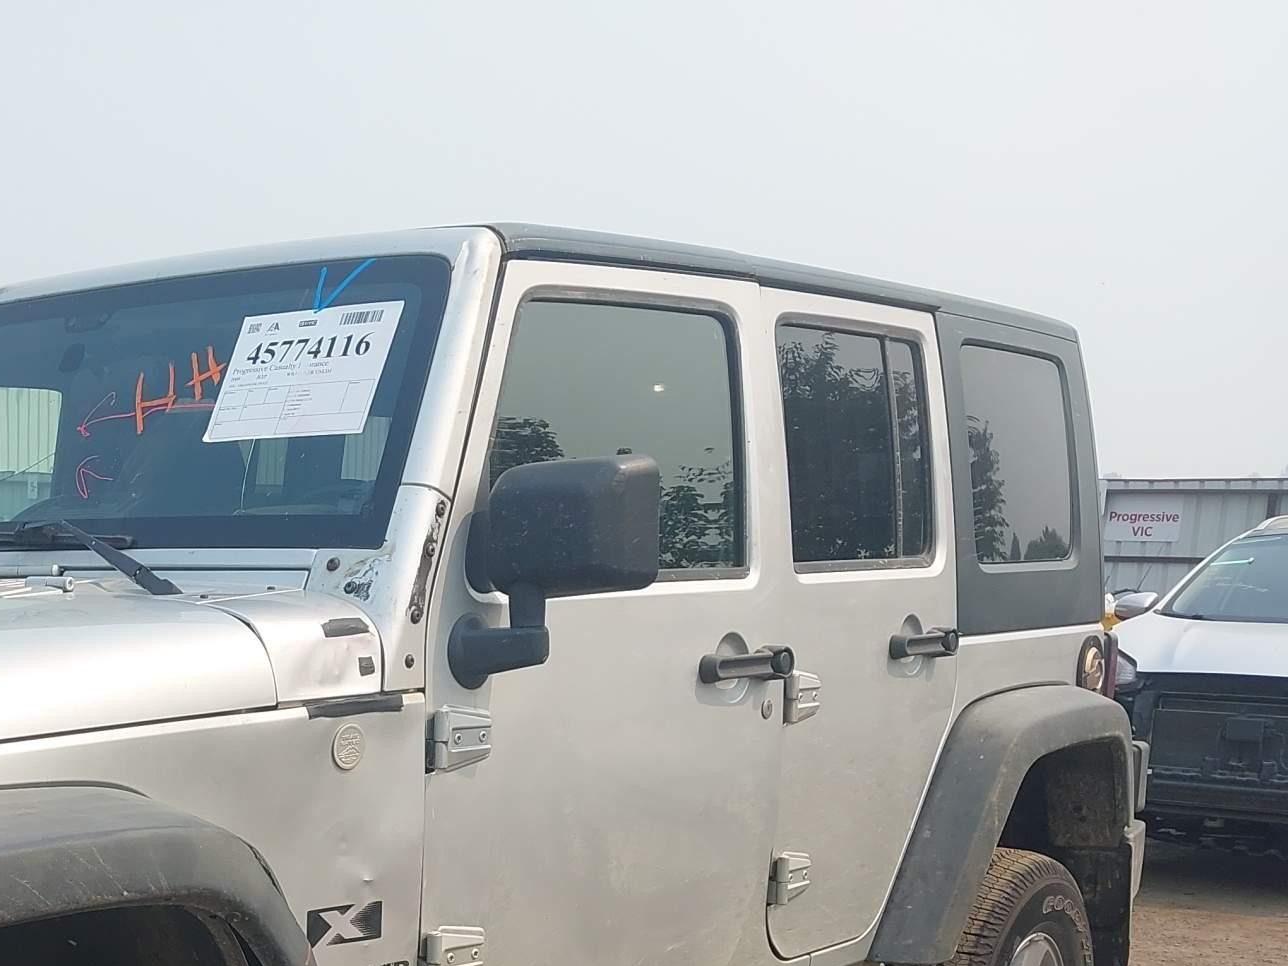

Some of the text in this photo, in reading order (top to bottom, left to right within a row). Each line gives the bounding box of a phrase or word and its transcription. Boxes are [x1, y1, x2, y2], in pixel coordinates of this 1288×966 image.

[246, 332, 375, 365] 45774116
[232, 366, 268, 376] Progressive
[1109, 511, 1180, 523] Progressive
[1132, 526, 1153, 537] VIC
